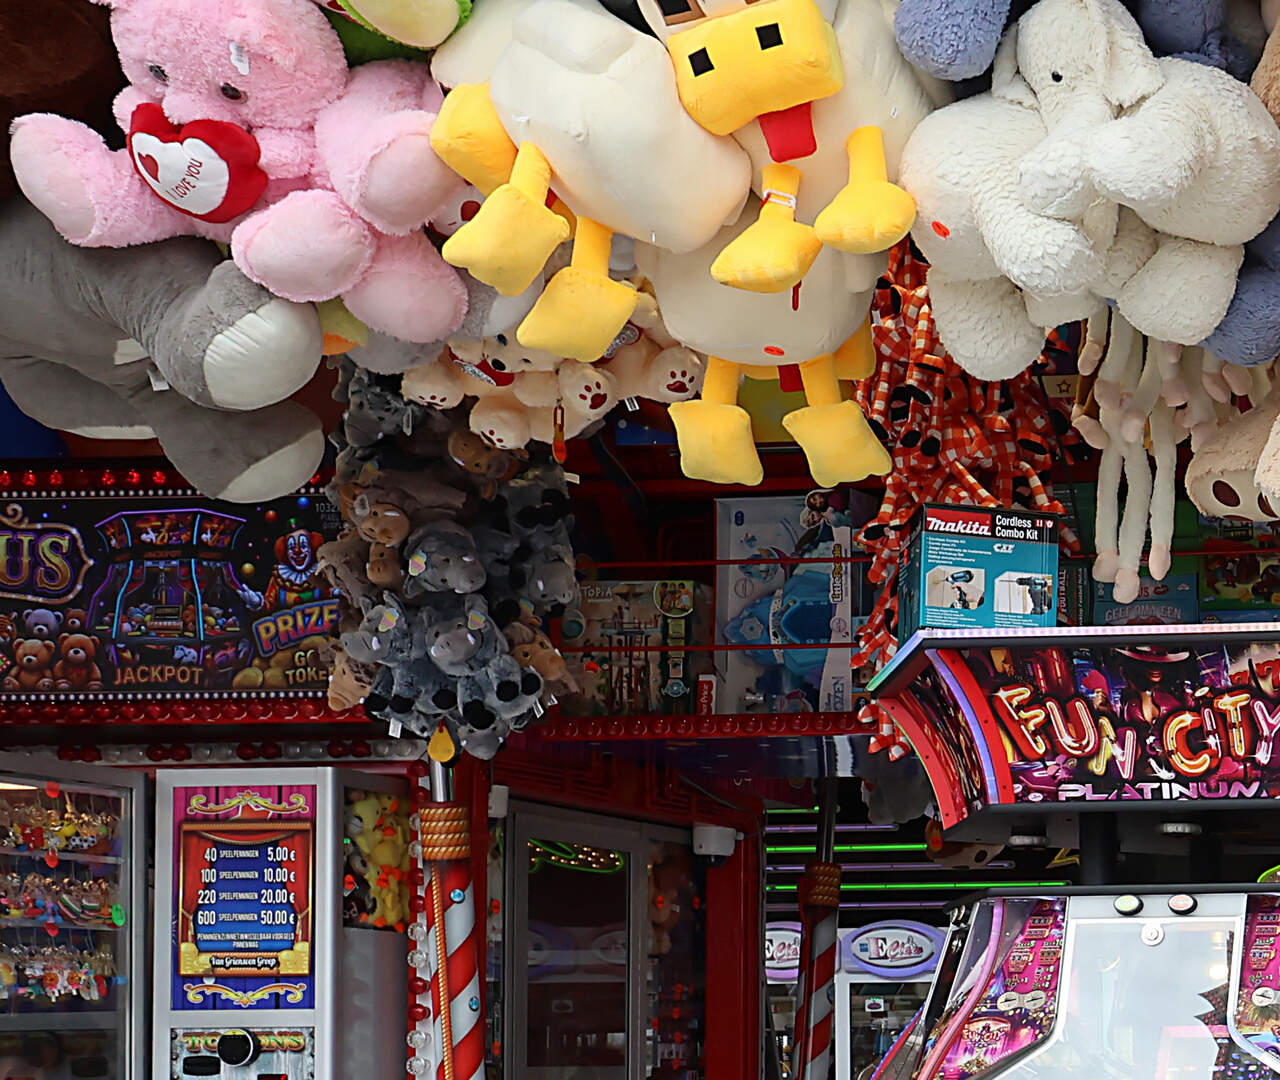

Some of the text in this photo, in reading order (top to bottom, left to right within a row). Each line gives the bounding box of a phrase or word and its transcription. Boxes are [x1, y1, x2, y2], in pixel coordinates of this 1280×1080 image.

[171, 178, 196, 199] LOVE
[185, 157, 203, 180] YOU
[926, 515, 1032, 536] makita Cordless
[995, 527, 1038, 540] Combo Kit
[114, 665, 203, 686] JACKPOT
[285, 667, 331, 685] TOKE
[995, 683, 1138, 780] FUN
[1057, 782, 1261, 801] PLATINUM
[204, 848, 217, 863] 40
[267, 847, 288, 863] 5,00
[200, 868, 217, 883] 100
[263, 868, 288, 884] 10,00
[198, 889, 216, 904] 220
[260, 889, 287, 905] 20,00
[197, 910, 216, 925] 600
[260, 910, 287, 926] 50,00
[182, 1031, 306, 1053] TONS
